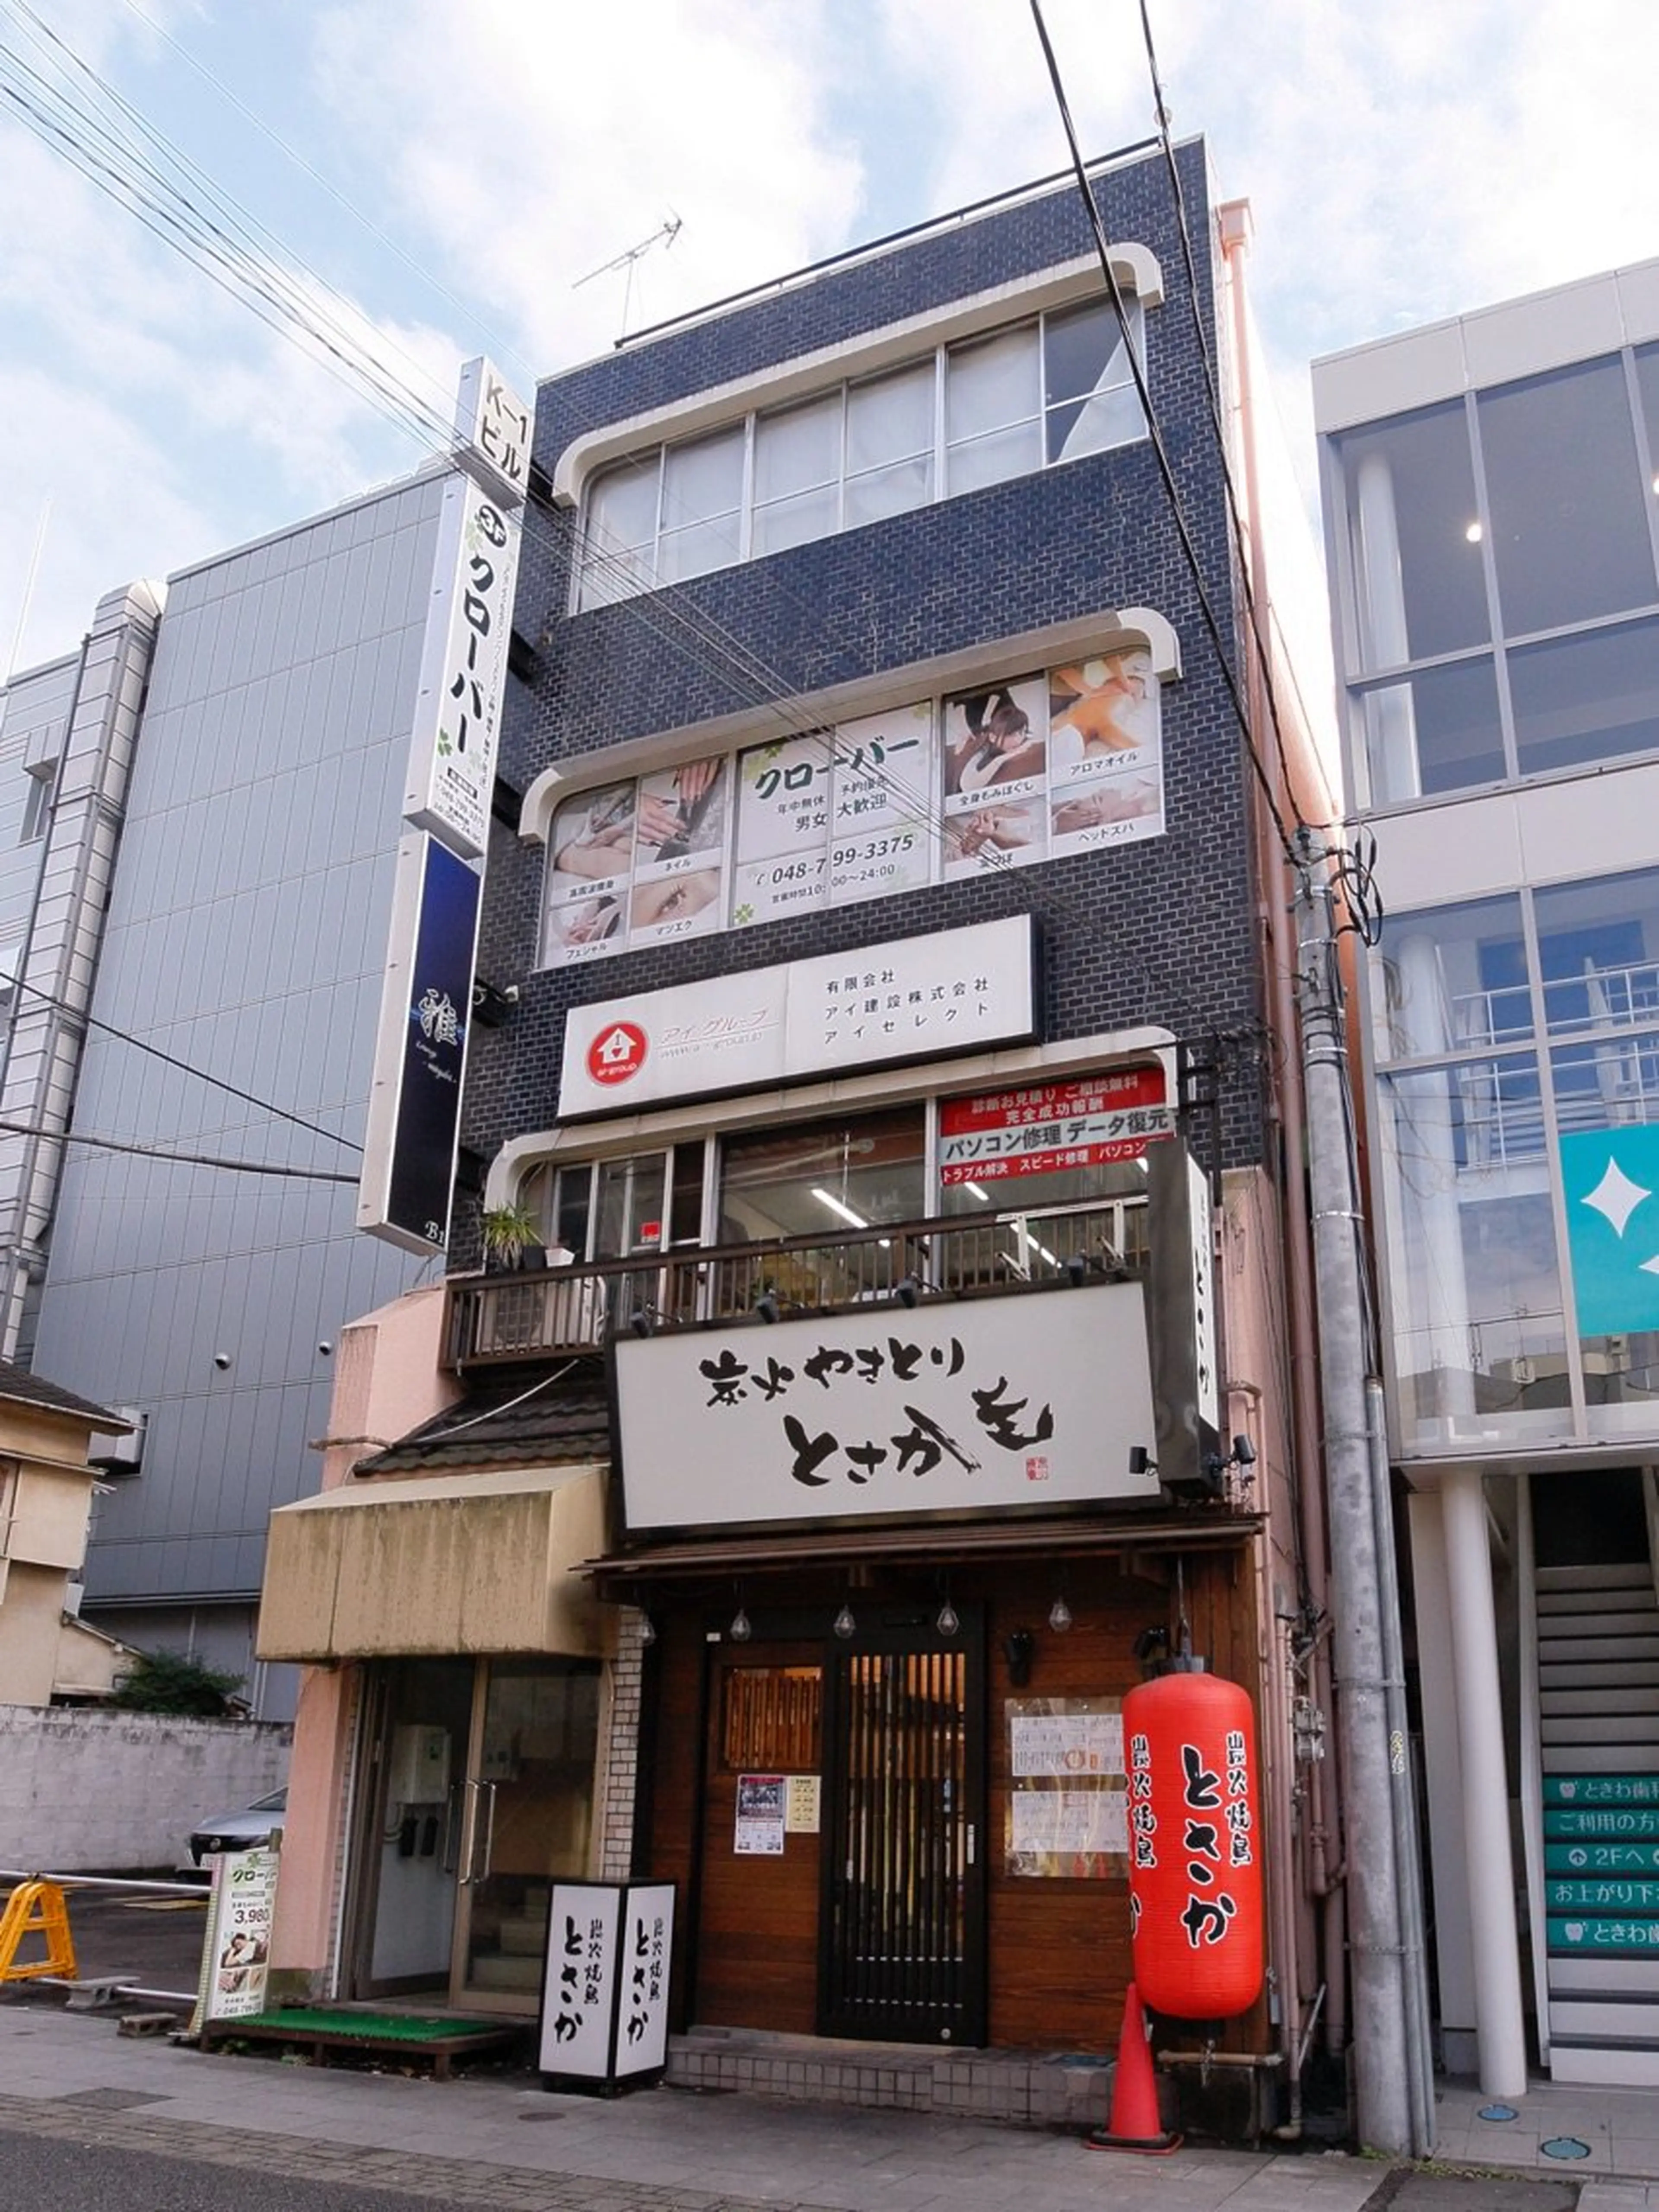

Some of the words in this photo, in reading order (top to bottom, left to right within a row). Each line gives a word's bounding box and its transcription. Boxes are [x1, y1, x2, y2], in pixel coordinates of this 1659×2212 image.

[481, 416, 521, 478] ビル
[451, 556, 495, 754] クローバー
[755, 736, 919, 799] クローバー
[1070, 750, 1139, 776] アロマオイル
[825, 977, 988, 1020] アイ建設株式会社
[826, 969, 894, 994] 有限会社
[824, 1002, 988, 1045] アイセレクト
[946, 1124, 1062, 1159] パソコン修理
[1067, 1109, 1168, 1143] データ復元
[943, 1163, 1008, 1183] トラブル解決
[1020, 1150, 1089, 1171] スピード修理
[783, 1405, 982, 1486] とさか
[1182, 1745, 1236, 1948] とさか
[1559, 1812, 1659, 1832] ご利用の方
[1555, 1884, 1659, 1904] お上がり下
[555, 1915, 583, 2044] とさか
[627, 1918, 649, 2046] とさか
